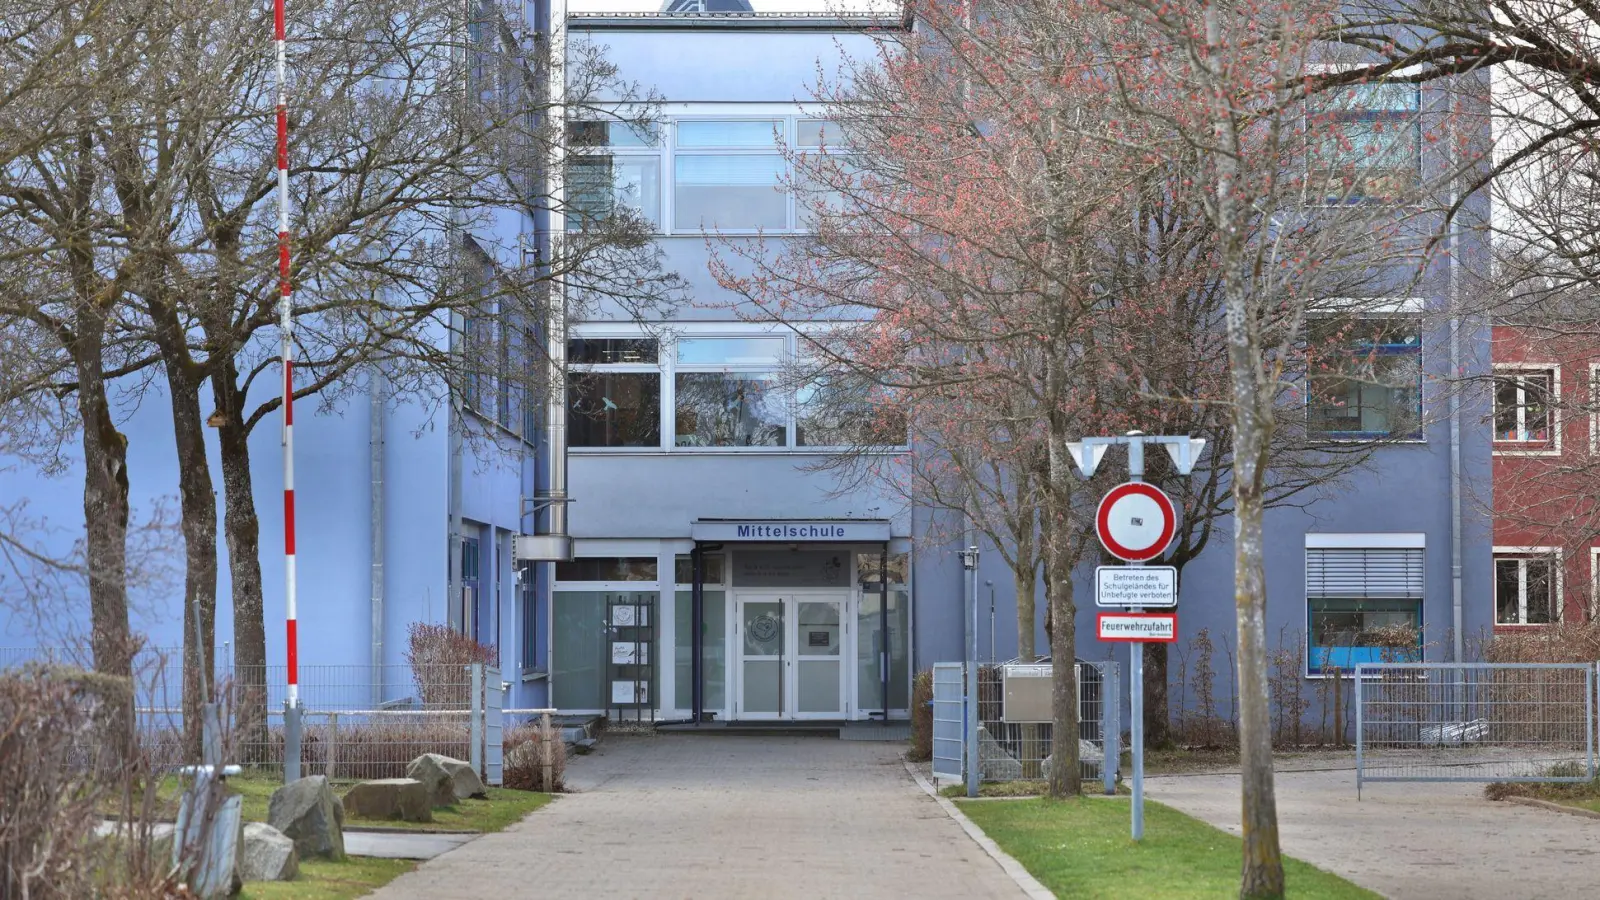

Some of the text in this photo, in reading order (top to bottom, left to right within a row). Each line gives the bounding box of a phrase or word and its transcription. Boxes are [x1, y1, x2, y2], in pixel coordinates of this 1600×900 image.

[737, 525, 845, 537] Mittelschule
[1103, 582, 1169, 591] Schulgeländes für
[1101, 591, 1138, 600] Unbefugte
[1101, 621, 1172, 631] Feuerwehrzufahrt
